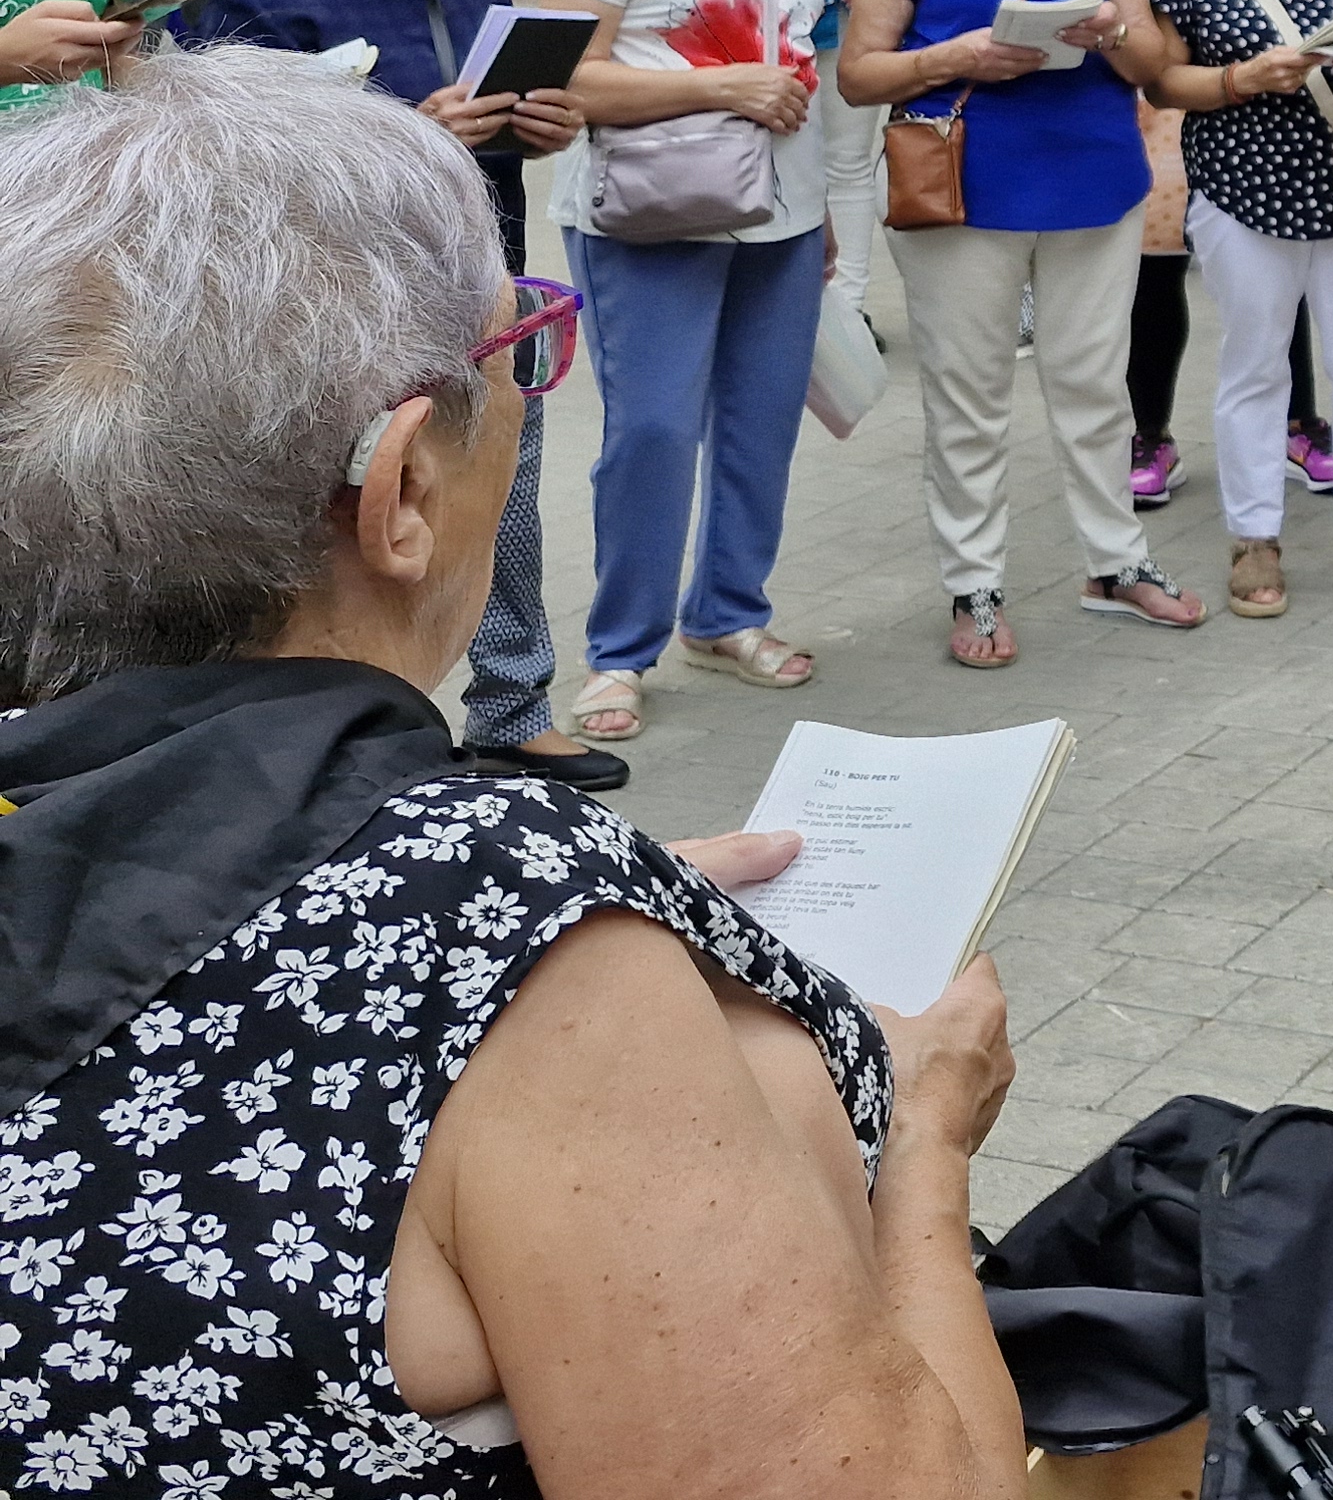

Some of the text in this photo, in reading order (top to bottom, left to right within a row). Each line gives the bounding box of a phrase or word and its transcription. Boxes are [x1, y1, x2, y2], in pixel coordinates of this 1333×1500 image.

[823, 768, 840, 777] 110
[848, 772, 870, 780] BOIG
[814, 779, 837, 790] (Sau)
[805, 800, 815, 808] En
